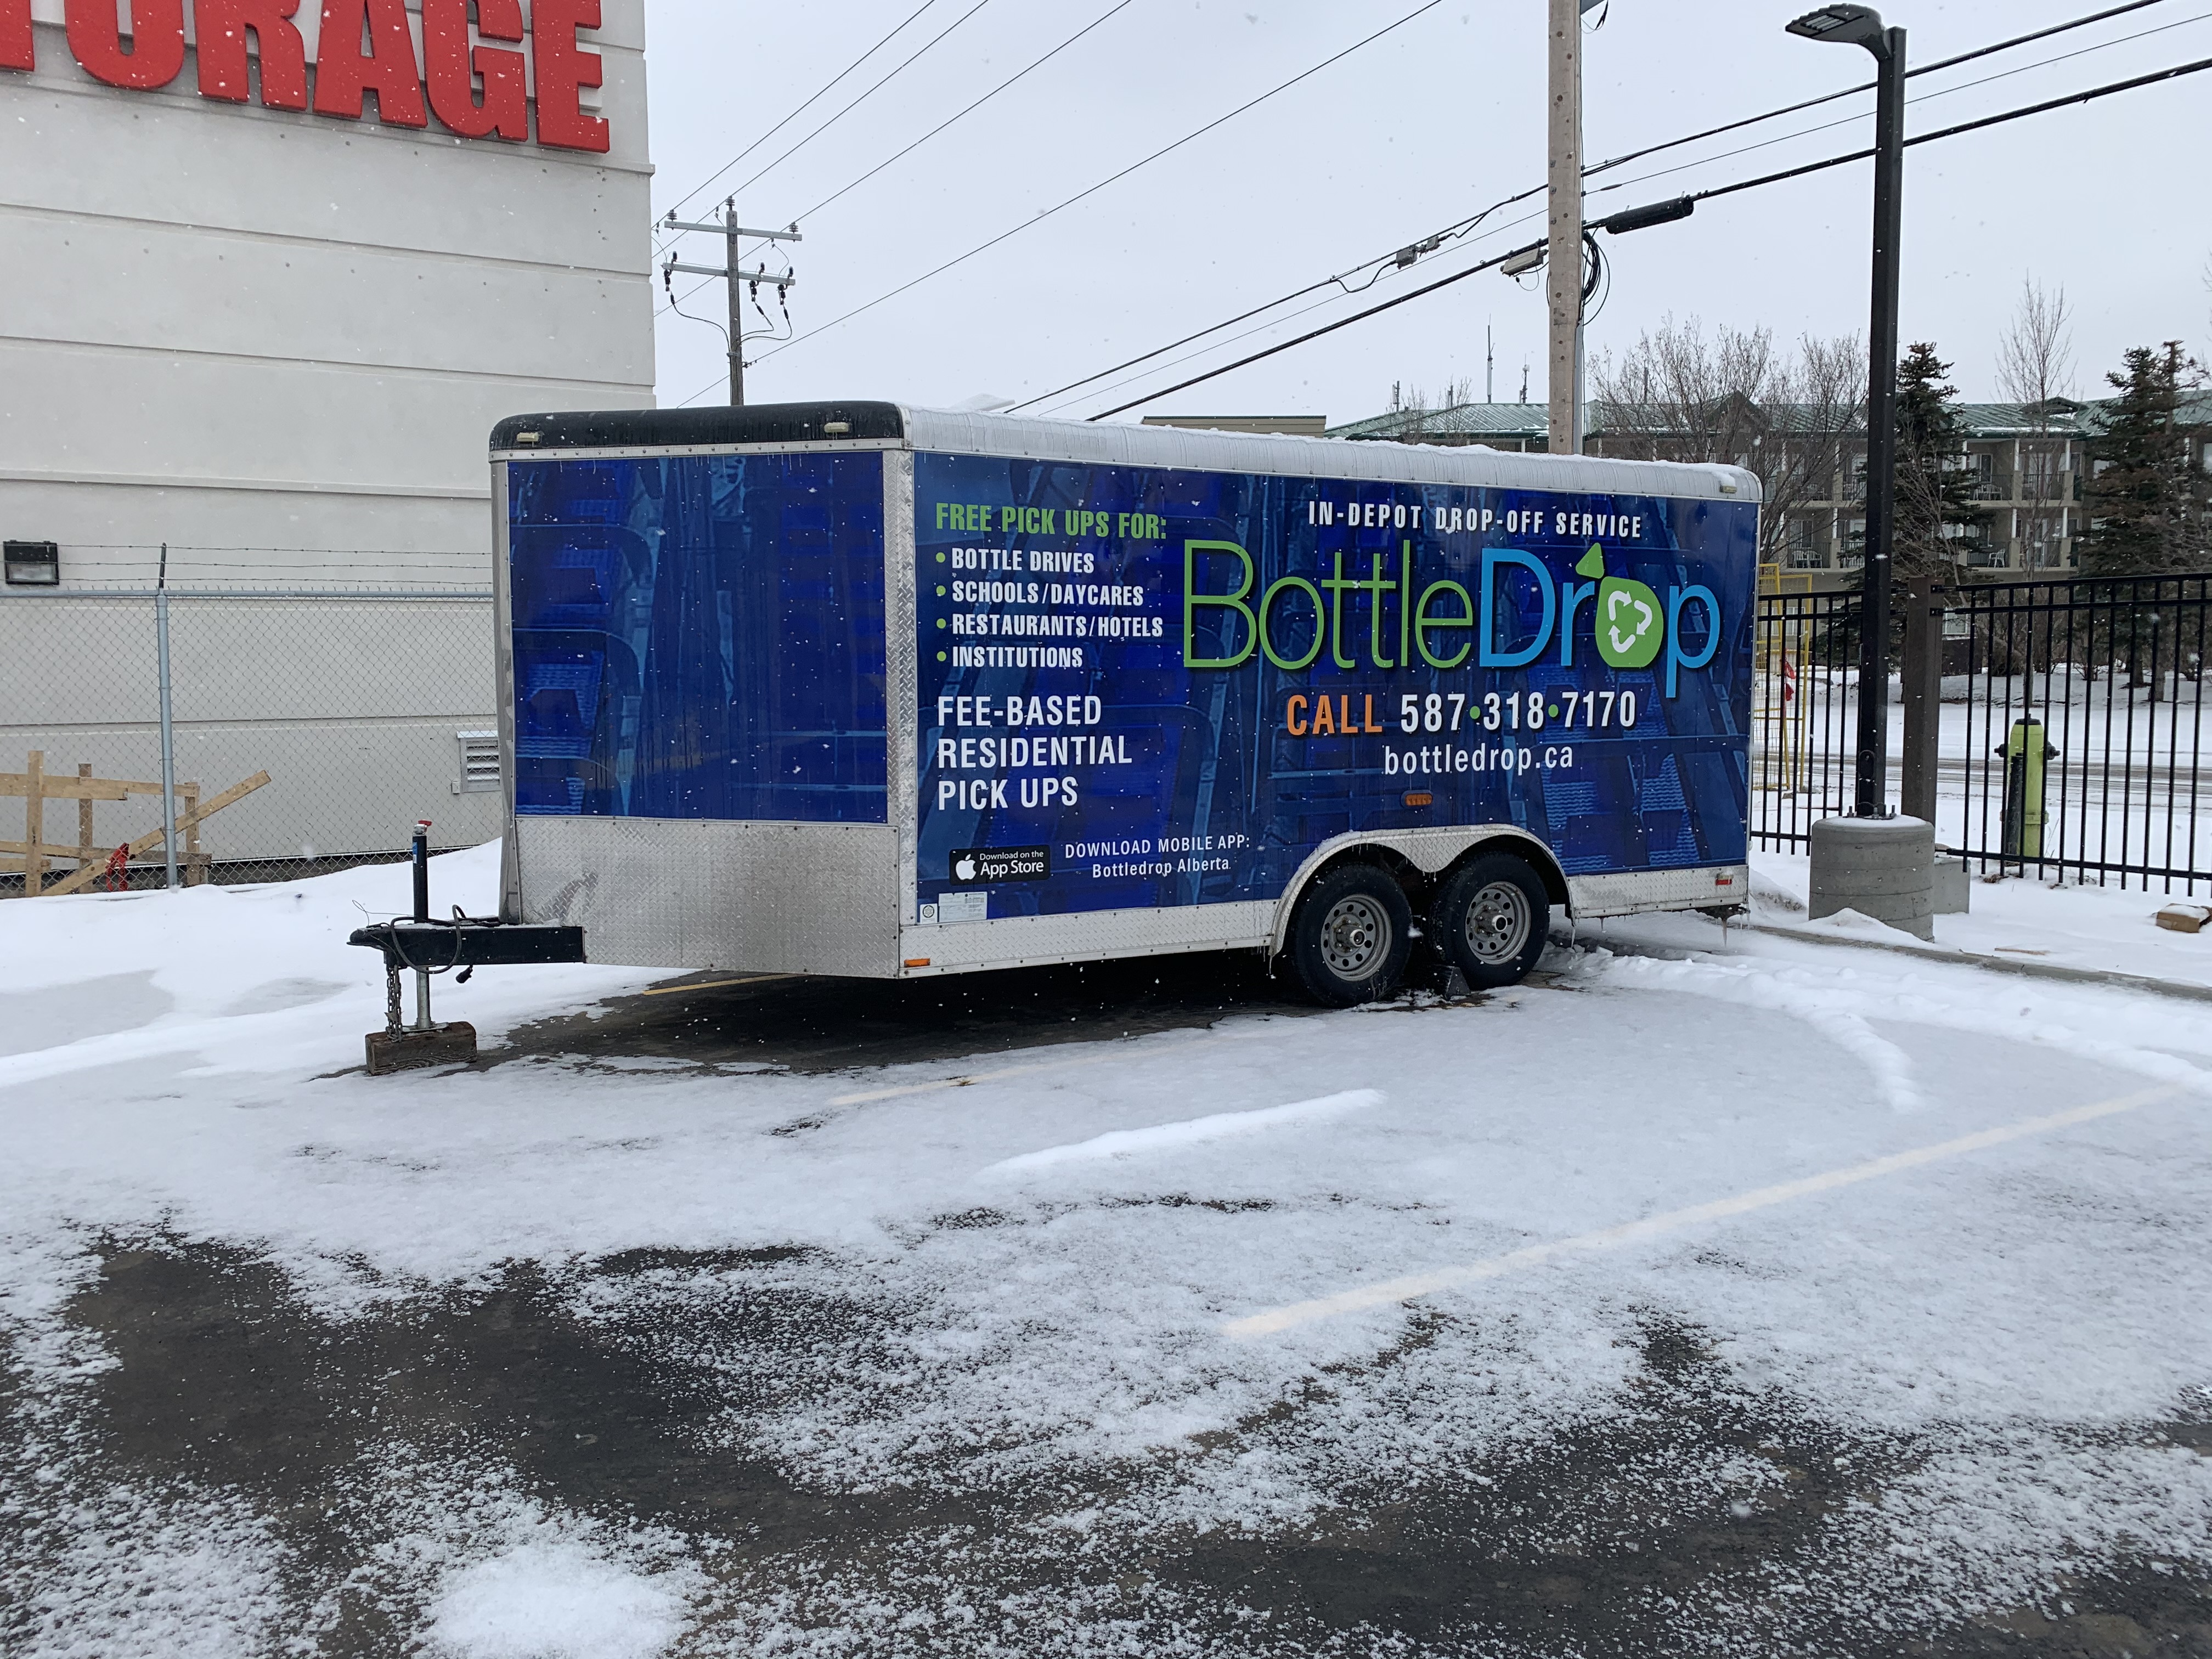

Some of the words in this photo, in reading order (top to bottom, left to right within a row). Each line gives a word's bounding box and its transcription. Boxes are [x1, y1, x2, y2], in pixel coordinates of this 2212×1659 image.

[936, 503, 992, 531] FREE
[1002, 506, 1055, 534] PICK
[1065, 510, 1109, 537] UPS
[1119, 513, 1166, 539] FOR:
[1309, 501, 1421, 528] IN-DEPOT
[1435, 506, 1544, 533] DROP-OFF
[1556, 512, 1641, 538] SERVICE
[952, 548, 1022, 571] BOTTLE
[1030, 551, 1094, 573] DRIVES
[952, 580, 1143, 606] SCHOOLS/DAYCARES
[952, 613, 1163, 637] RESTAURANTS/HOTELS
[953, 646, 1082, 668] INSTITUTIONS
[938, 695, 1101, 726] FEE-BASED
[1287, 694, 1383, 736] CALL
[938, 735, 1132, 768] RESIDENTIAL
[1385, 743, 1573, 776] bottledrop.ca
[939, 779, 1008, 810] PICK
[1021, 776, 1078, 808] UPS
[980, 851, 1018, 860] Download
[1065, 839, 1151, 859] DOWNLOAD
[1158, 836, 1213, 853] MOBILE
[1217, 834, 1250, 849] APP:
[980, 861, 1008, 878] App
[1011, 860, 1044, 873] Store
[1092, 860, 1172, 878] Bottledrop
[1177, 857, 1229, 873] Alberta
